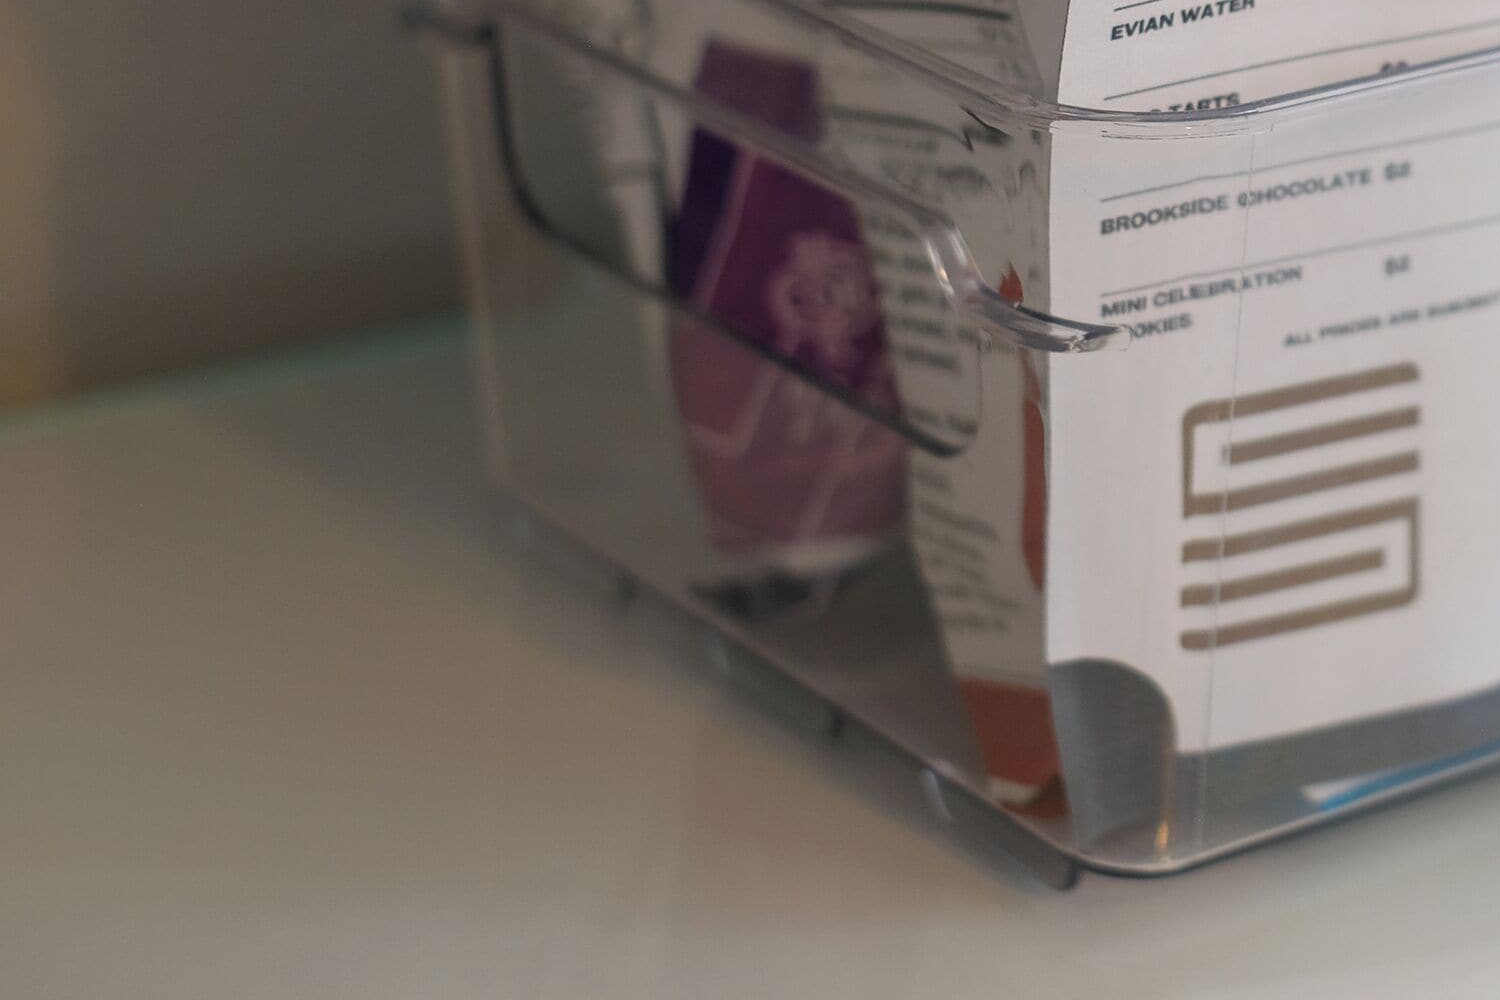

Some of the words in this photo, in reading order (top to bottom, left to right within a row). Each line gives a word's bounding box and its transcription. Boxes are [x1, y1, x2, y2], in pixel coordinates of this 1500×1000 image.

[1110, 11, 1175, 41] EVIAN
[1100, 195, 1230, 236] BROOKSIDE
[1237, 168, 1371, 208] CHOCOLATE
[1100, 296, 1147, 319] MINI
[1152, 266, 1303, 308] CELEBRATION
[1130, 312, 1193, 340] OKIES
